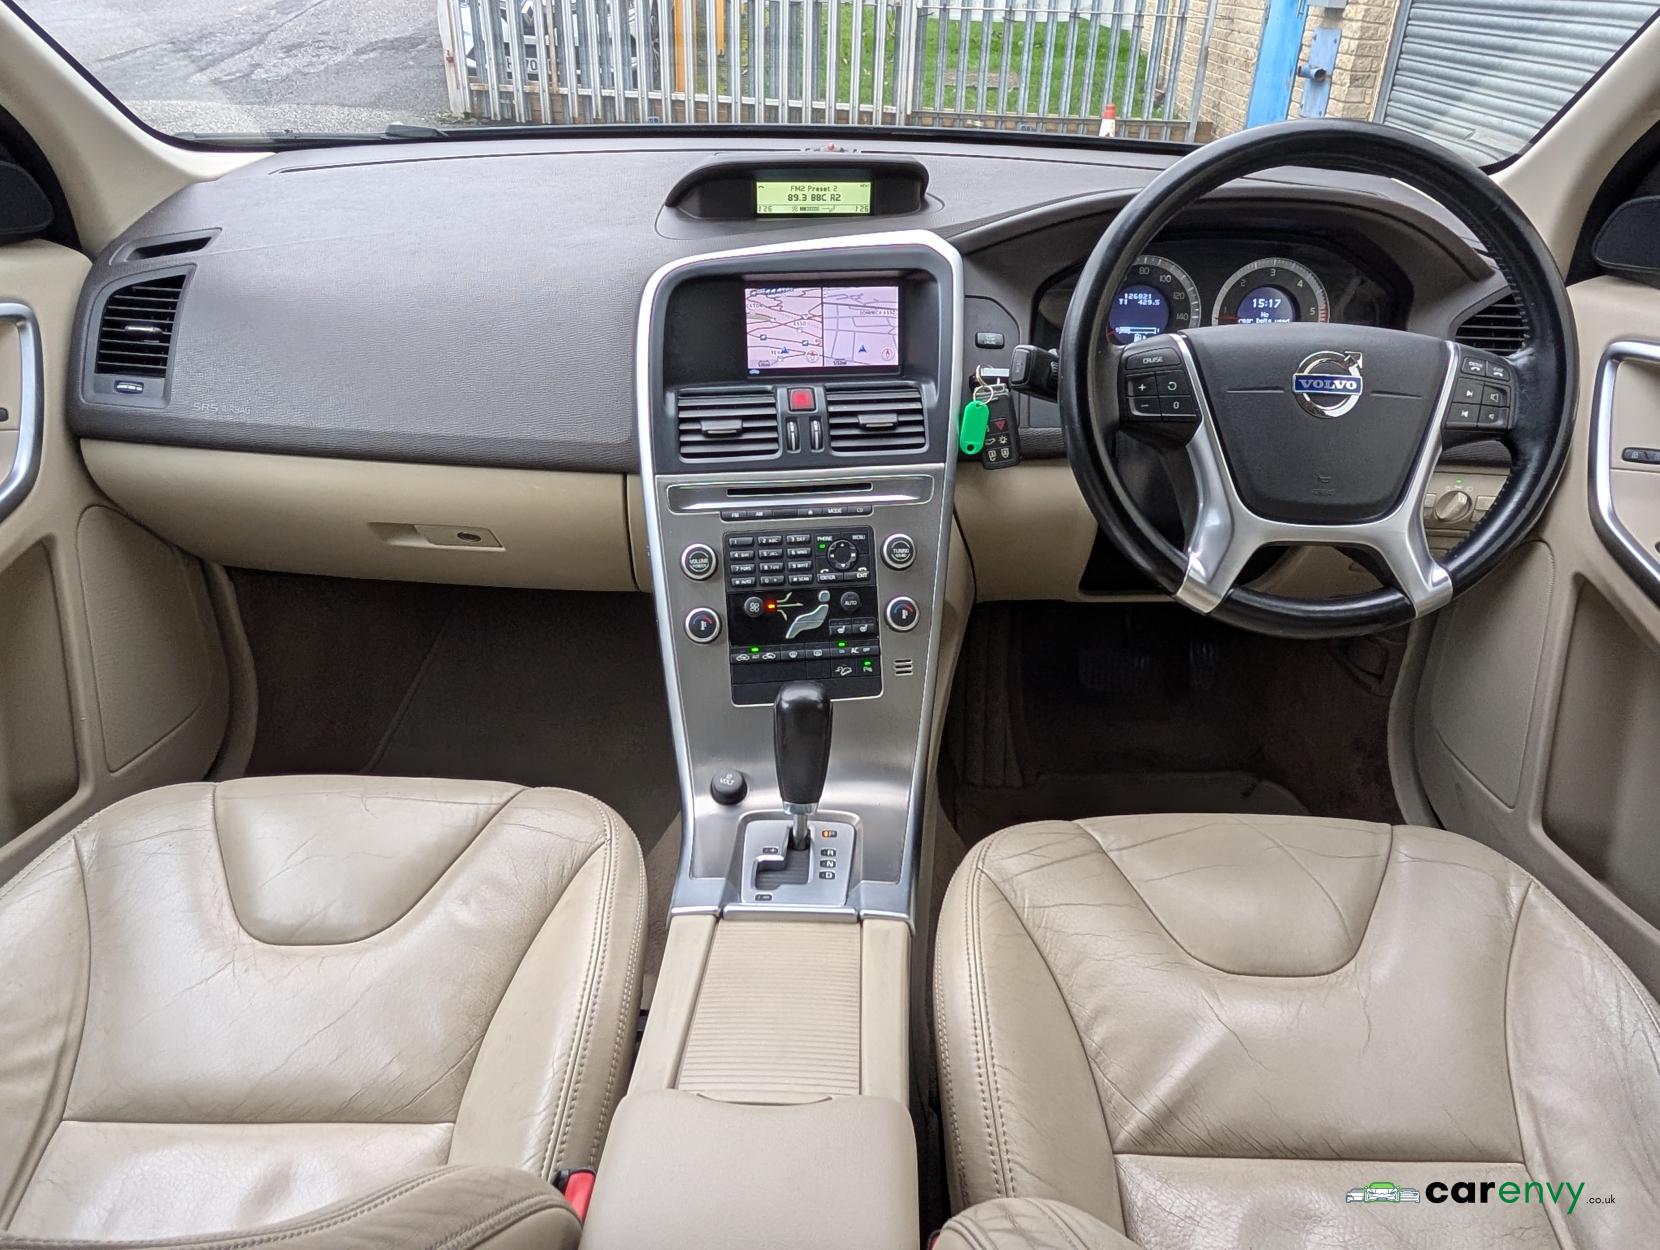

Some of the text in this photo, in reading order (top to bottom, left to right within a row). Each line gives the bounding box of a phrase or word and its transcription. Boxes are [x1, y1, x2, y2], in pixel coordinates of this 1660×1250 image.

[787, 193, 841, 202] 89.3 BBC R2
[1139, 267, 1150, 275] 80
[1270, 269, 1277, 277] 3
[1159, 275, 1172, 283] 100
[1297, 280, 1304, 288] 4
[1252, 298, 1282, 309] 15:17
[1309, 307, 1316, 316] 5
[1299, 379, 1358, 390] VOLVO
